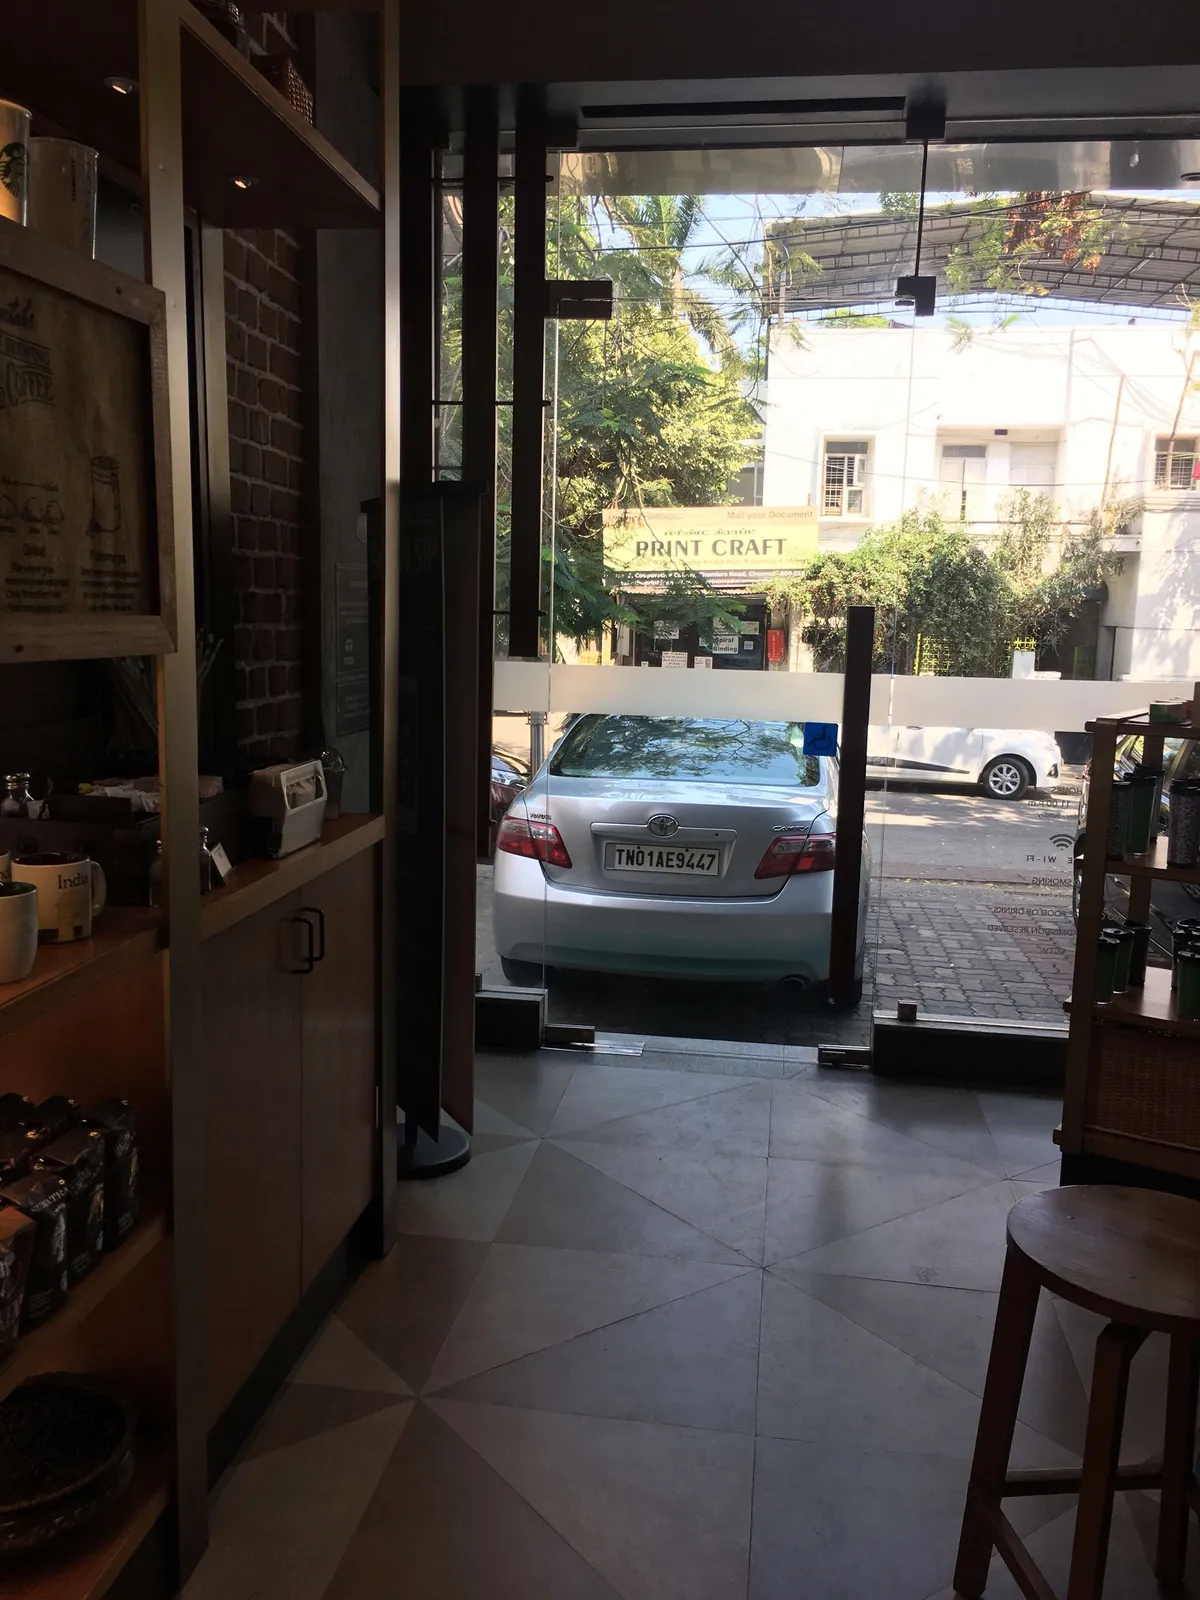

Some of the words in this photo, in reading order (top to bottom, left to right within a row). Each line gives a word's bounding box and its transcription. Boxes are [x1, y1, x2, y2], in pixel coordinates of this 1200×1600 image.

[747, 512, 766, 520] your
[768, 511, 813, 519] Document
[636, 540, 703, 557] PRINT
[712, 538, 787, 556] CRAFT
[713, 644, 738, 654] Binding
[616, 848, 716, 871] TN01AE9447
[58, 872, 89, 889] India
